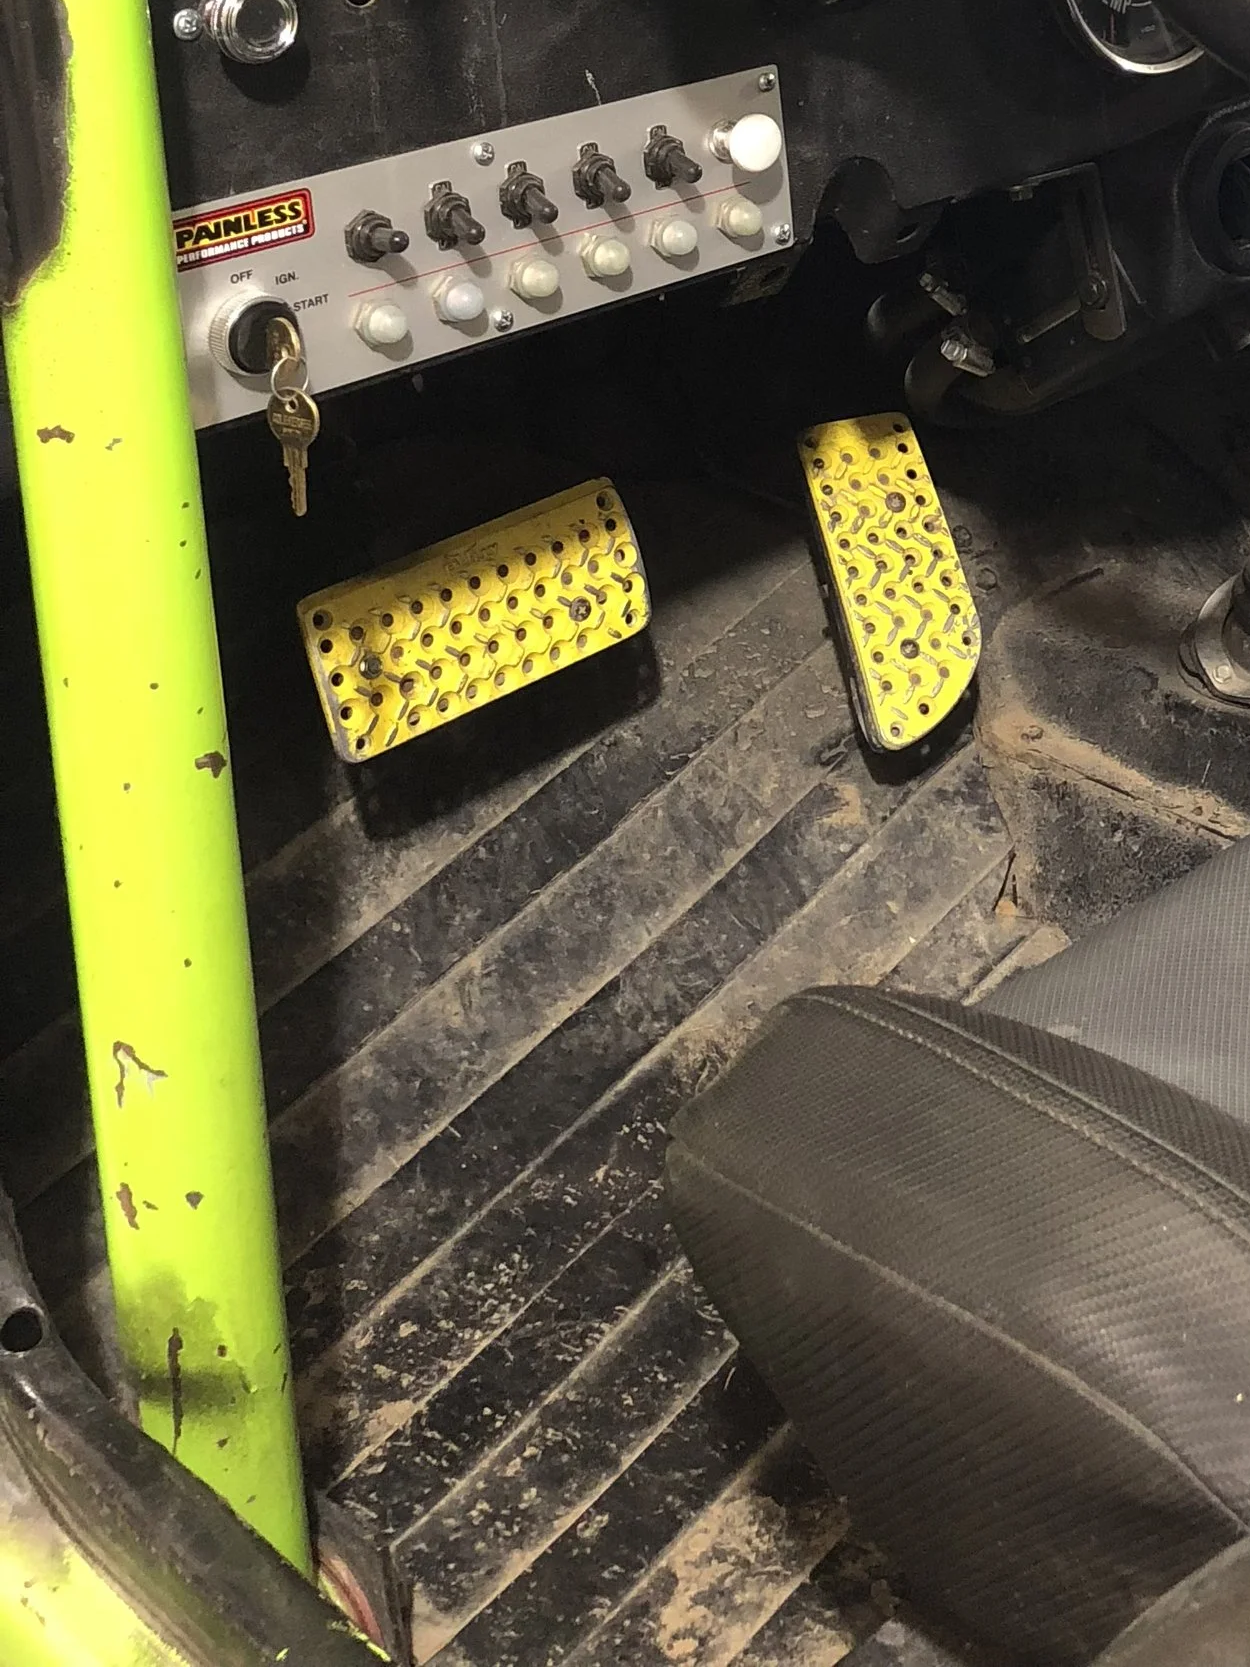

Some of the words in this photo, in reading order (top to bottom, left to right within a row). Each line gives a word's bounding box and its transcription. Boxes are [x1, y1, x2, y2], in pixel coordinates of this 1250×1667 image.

[175, 200, 302, 250] PAINLESS
[176, 237, 249, 265] PERFORMANCE
[251, 223, 305, 246] PRODUCTS
[230, 269, 253, 284] OFF
[293, 293, 329, 312] START
